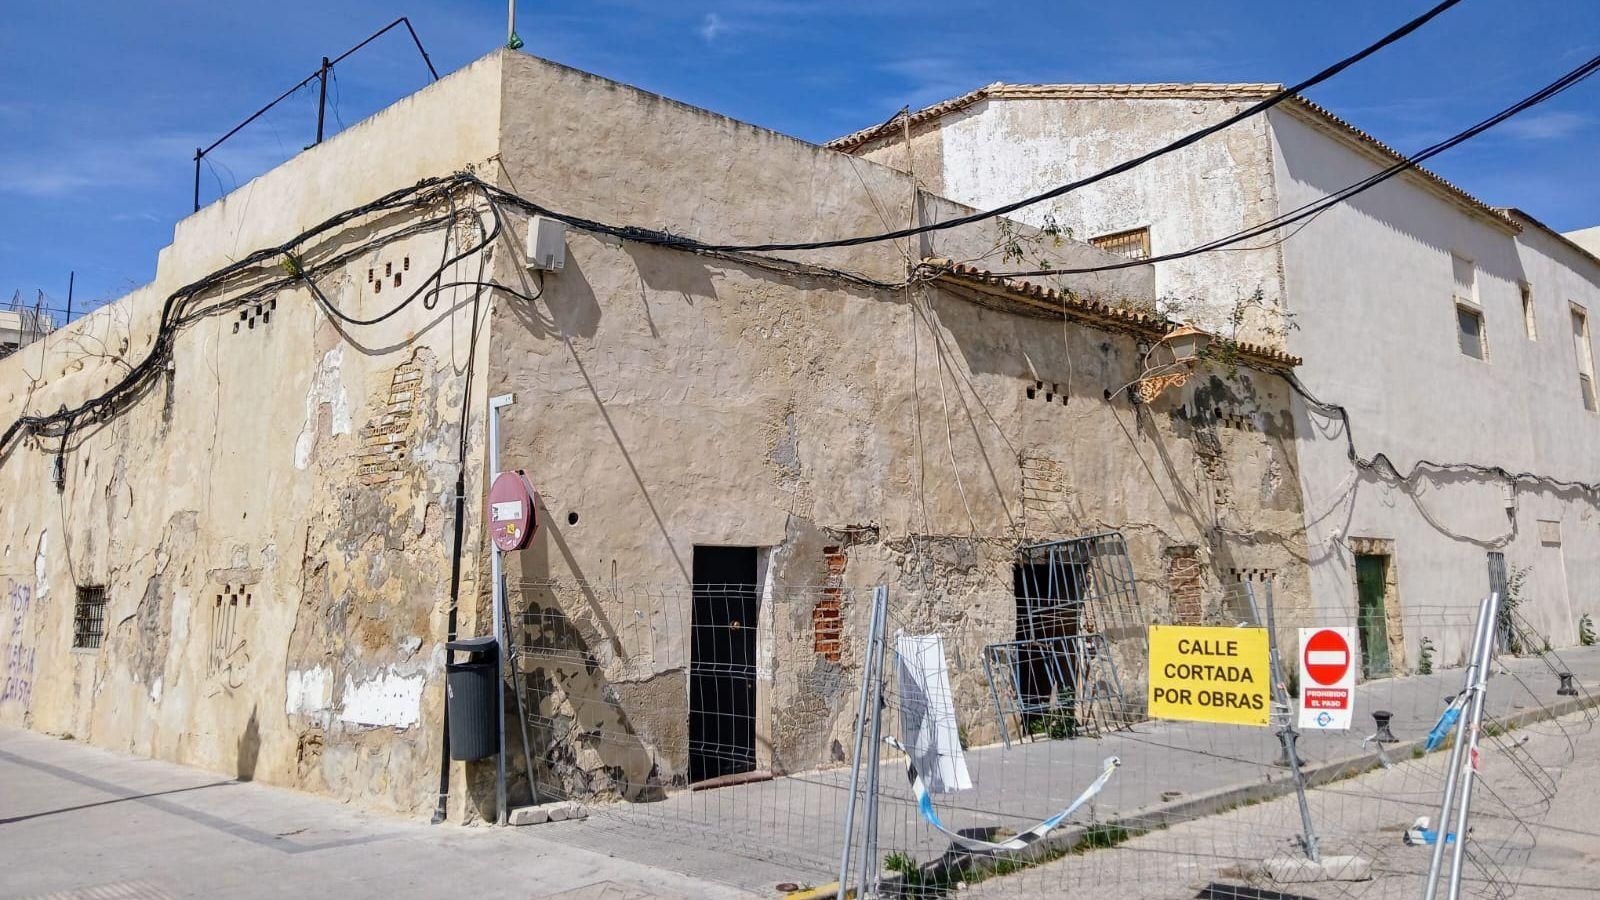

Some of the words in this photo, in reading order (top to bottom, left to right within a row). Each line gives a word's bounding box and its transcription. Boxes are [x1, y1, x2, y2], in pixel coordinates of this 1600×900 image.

[1178, 639, 1238, 656] CALLE
[1164, 663, 1254, 683] CORTADA
[1154, 688, 1192, 705] POR
[1198, 690, 1264, 710] OBRAS
[1307, 690, 1347, 698] PROHIBIDO
